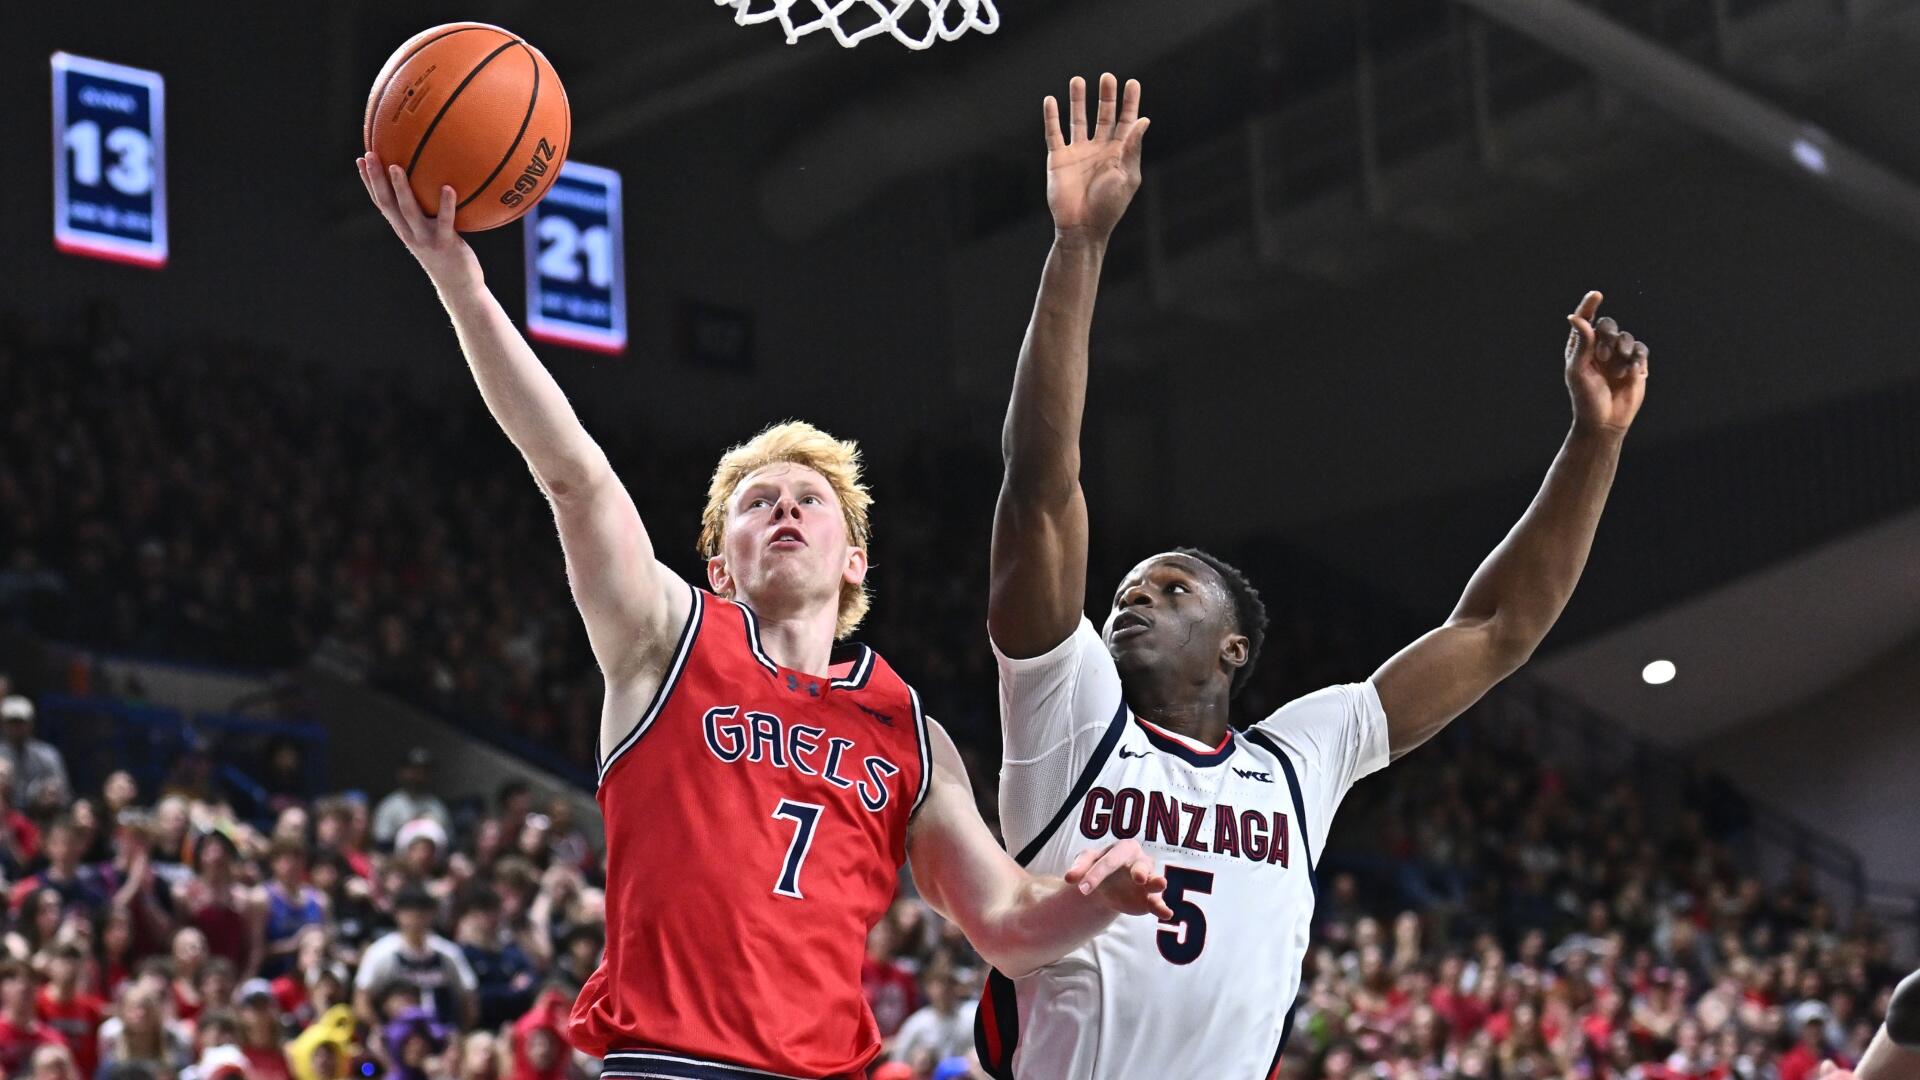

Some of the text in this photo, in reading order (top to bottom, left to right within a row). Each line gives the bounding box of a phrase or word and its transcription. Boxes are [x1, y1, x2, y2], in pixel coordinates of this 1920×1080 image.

[63, 118, 155, 195] 13
[500, 137, 557, 208] ZAGS
[535, 214, 613, 288] 21
[702, 705, 899, 812] GAELS
[1231, 766, 1275, 784] WCC
[771, 797, 825, 900] 7
[1079, 786, 1290, 870] GONZAGA
[1156, 864, 1215, 966] 5
